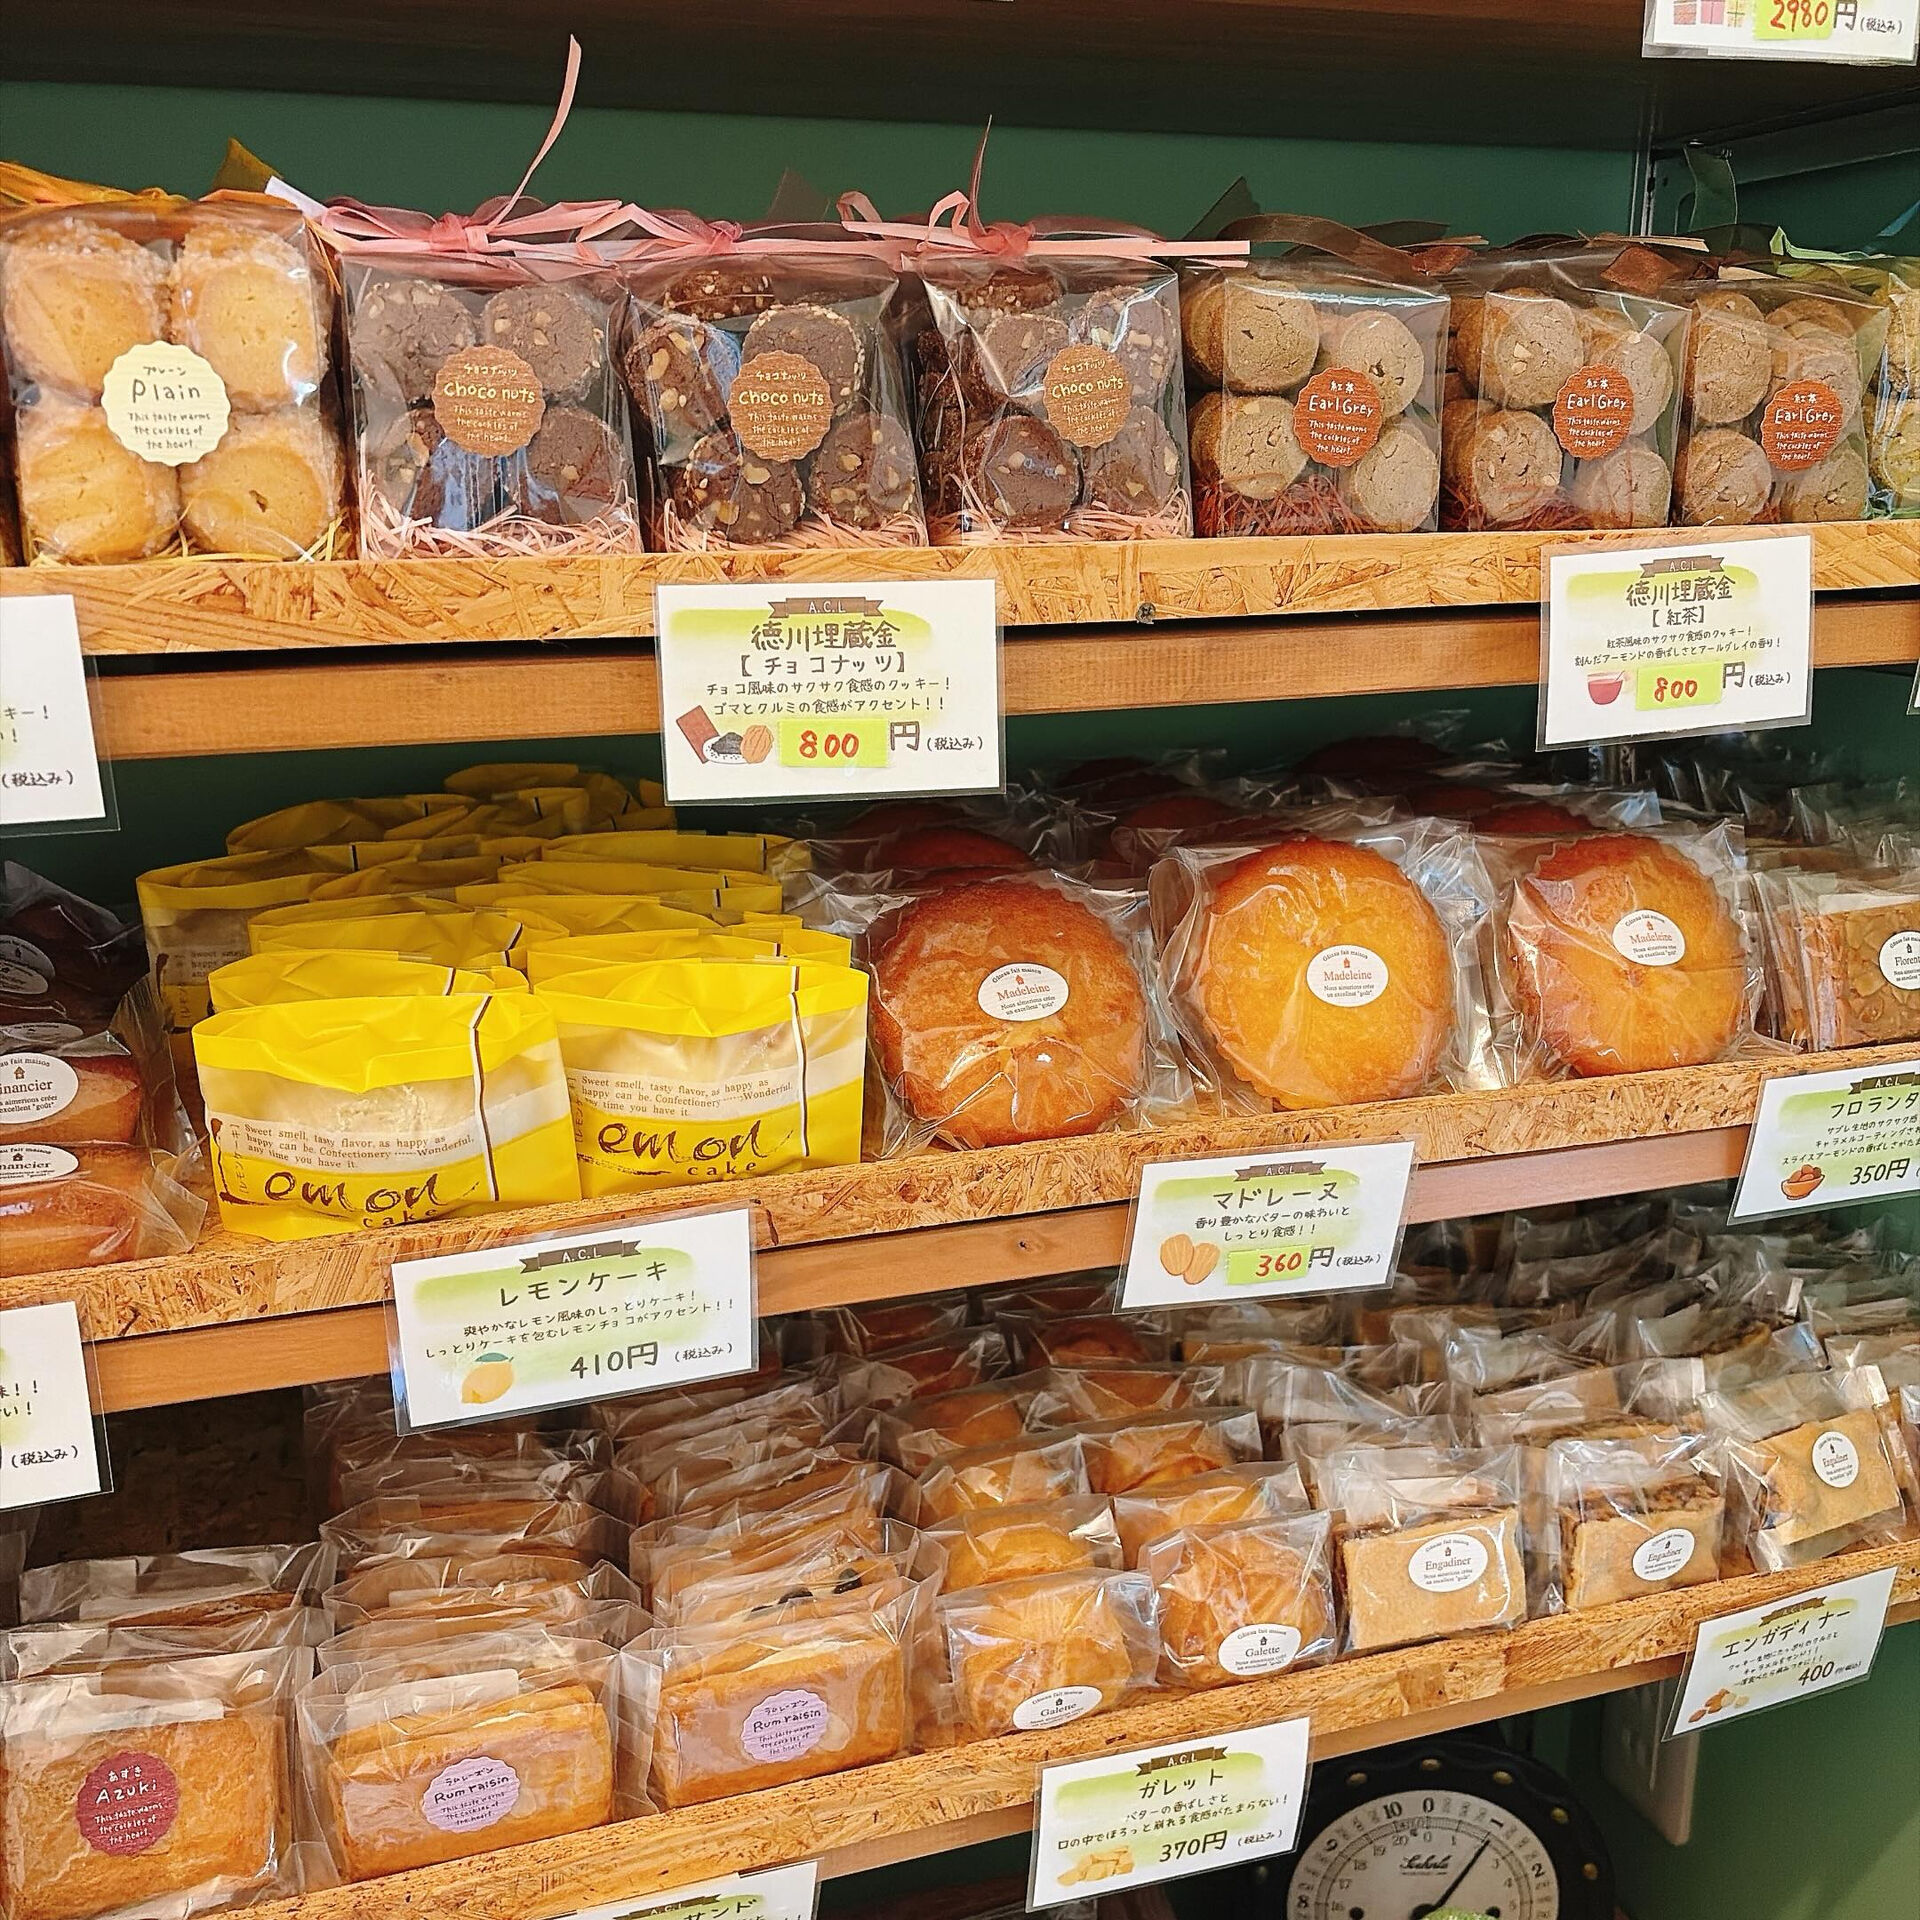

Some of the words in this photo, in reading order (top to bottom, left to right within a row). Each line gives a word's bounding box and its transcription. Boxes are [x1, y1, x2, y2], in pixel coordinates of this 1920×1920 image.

[143, 365, 186, 376] プレーン
[463, 363, 517, 376] チョコナッツ
[756, 370, 806, 381] チョコナッツ
[132, 378, 200, 403] Plain
[443, 381, 496, 399] Choco
[502, 387, 535, 404] nuts
[1052, 383, 1093, 398] Choco
[1097, 376, 1123, 390] nuts
[739, 390, 788, 405] Choco
[793, 390, 824, 405] nuts
[128, 412, 149, 420] This
[1309, 420, 1324, 428] This
[134, 425, 149, 434] the
[193, 425, 203, 435] of
[1310, 431, 1322, 439] the
[146, 440, 162, 449] the
[1626, 575, 1735, 606] 徳川埋蔵金
[808, 601, 846, 613] A.C.L
[751, 621, 900, 651] 徳川埋蔵金
[997, 984, 1051, 1001] Madeleine
[581, 1076, 609, 1087] Sweet
[650, 1083, 672, 1094] tasty
[711, 1088, 720, 1096] as
[725, 1081, 753, 1095] happy
[758, 1079, 769, 1087] as
[581, 1086, 609, 1098] happy
[615, 1091, 632, 1100] can
[603, 1100, 624, 1111] time
[629, 1104, 647, 1114] you
[653, 1106, 675, 1116] have
[245, 1124, 272, 1137] Sweet
[379, 1140, 390, 1148] as
[396, 1132, 428, 1149] happy
[434, 1136, 446, 1144] as
[247, 1134, 273, 1148] happy
[279, 1142, 297, 1151] can
[248, 1144, 264, 1155] any
[269, 1150, 289, 1161] time
[295, 1155, 312, 1166] you
[318, 1157, 341, 1168] have
[687, 1161, 757, 1176] cake
[1850, 1158, 1911, 1186] 350円
[363, 1209, 438, 1228] cake
[500, 1261, 668, 1308] レモンケーキ
[570, 1341, 658, 1380] 410円
[1425, 1557, 1472, 1571] Engadiner
[1722, 1610, 1851, 1659] エンガディナー
[1245, 1647, 1280, 1657] Galette
[109, 1766, 141, 1782] あずき
[96, 1779, 157, 1804] Azuki
[1140, 1768, 1224, 1799] ガレット
[1382, 1801, 1402, 1819] 10
[1159, 1830, 1228, 1863] 370円
